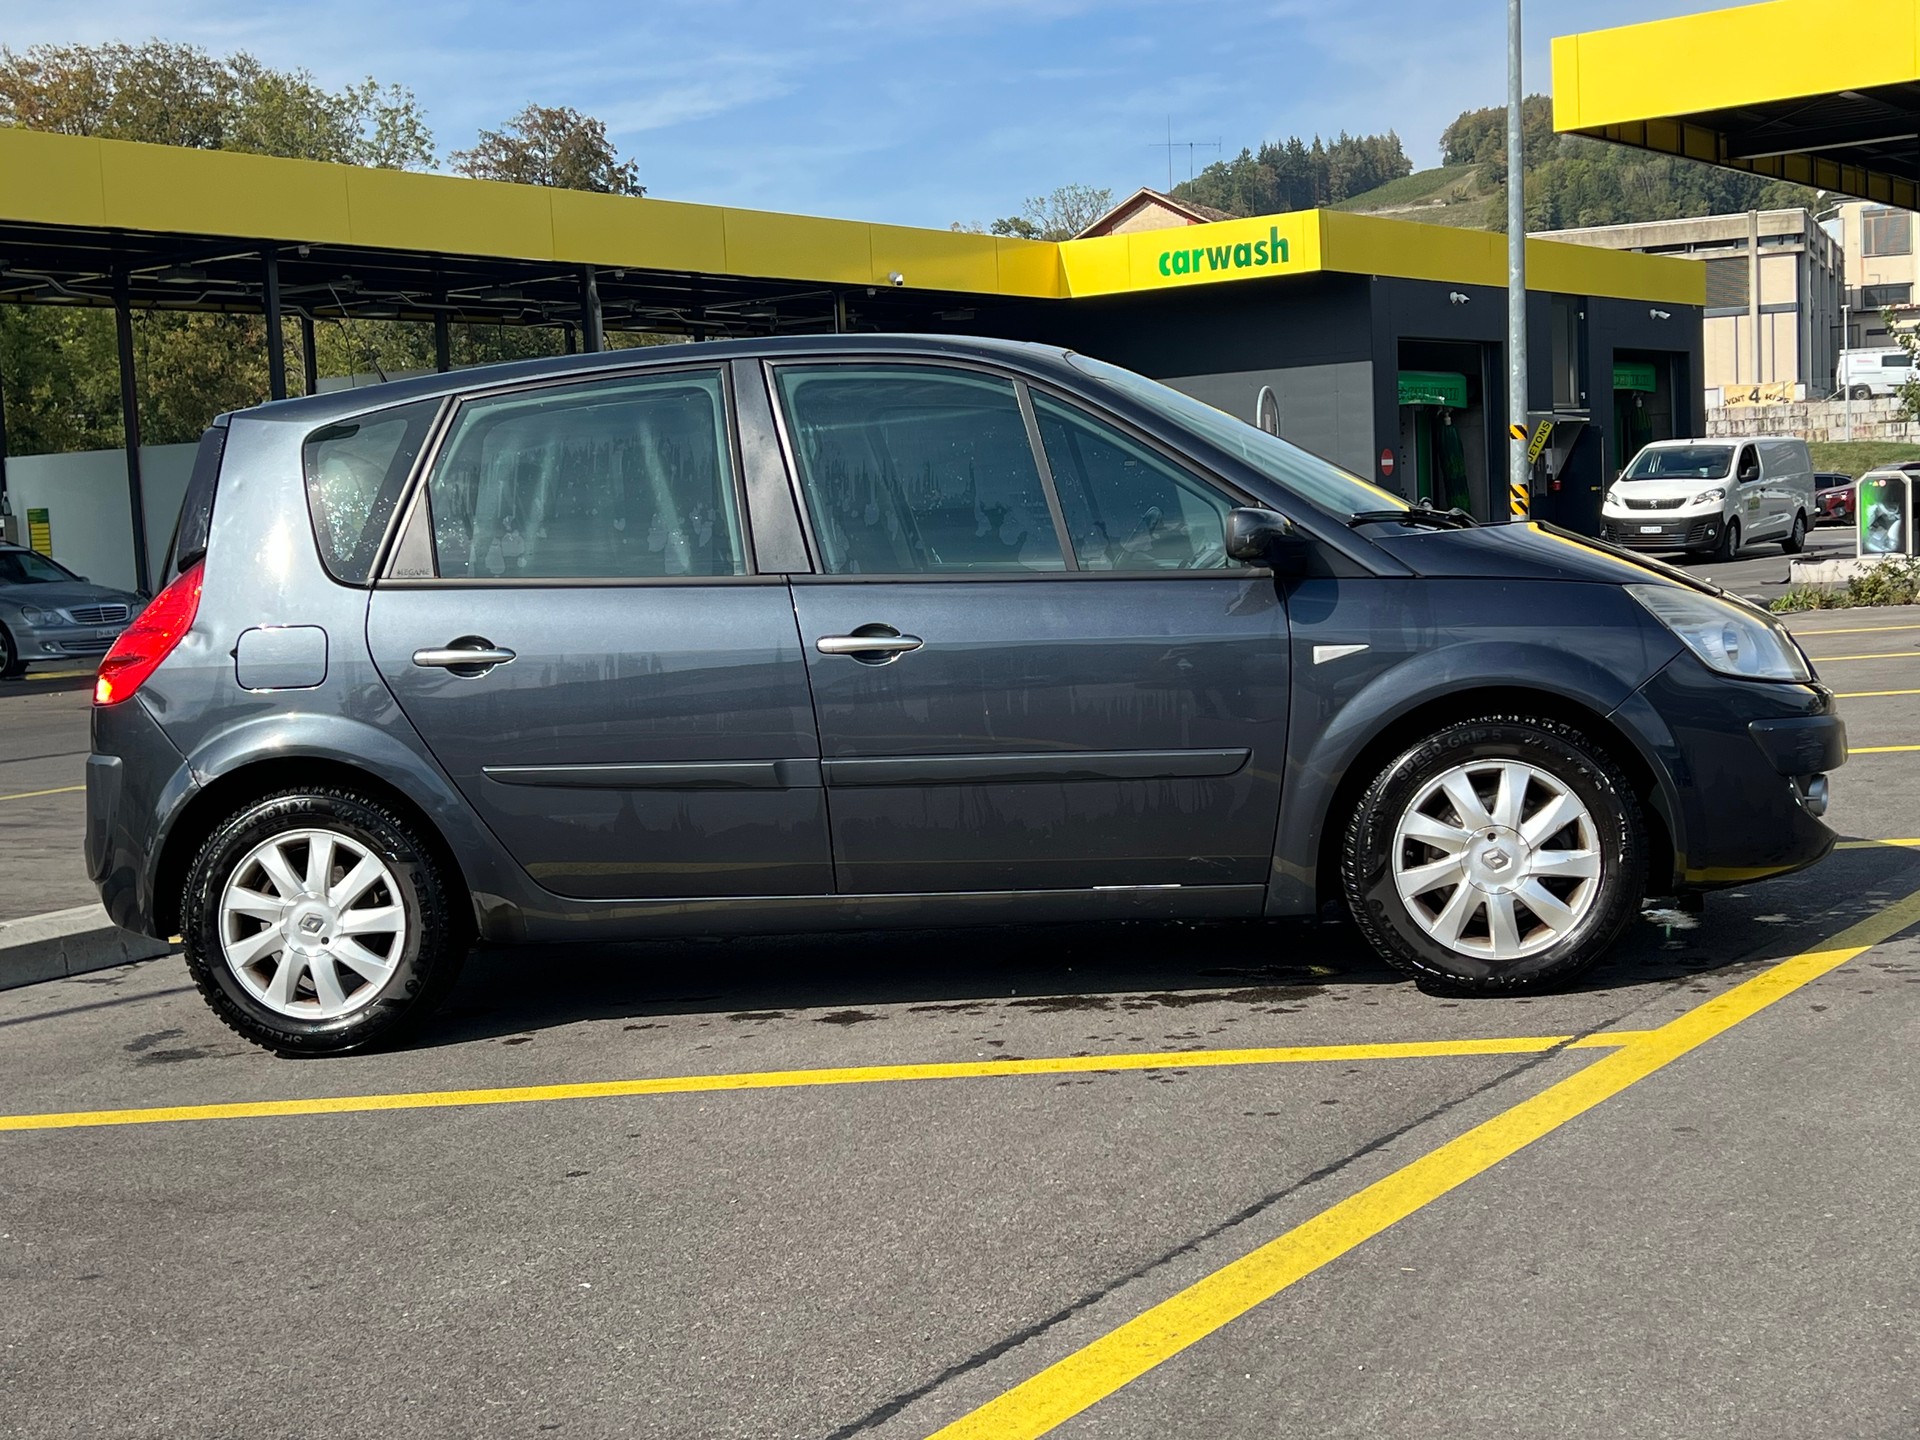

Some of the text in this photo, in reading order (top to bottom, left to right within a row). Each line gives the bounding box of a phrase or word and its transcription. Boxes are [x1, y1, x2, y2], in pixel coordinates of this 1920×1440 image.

[1158, 226, 1289, 276] carwash
[1748, 386, 1761, 404] 4
[1527, 421, 1551, 462] JETONS
[1396, 729, 1487, 781] SPEED-GRIP
[295, 799, 316, 812] XL
